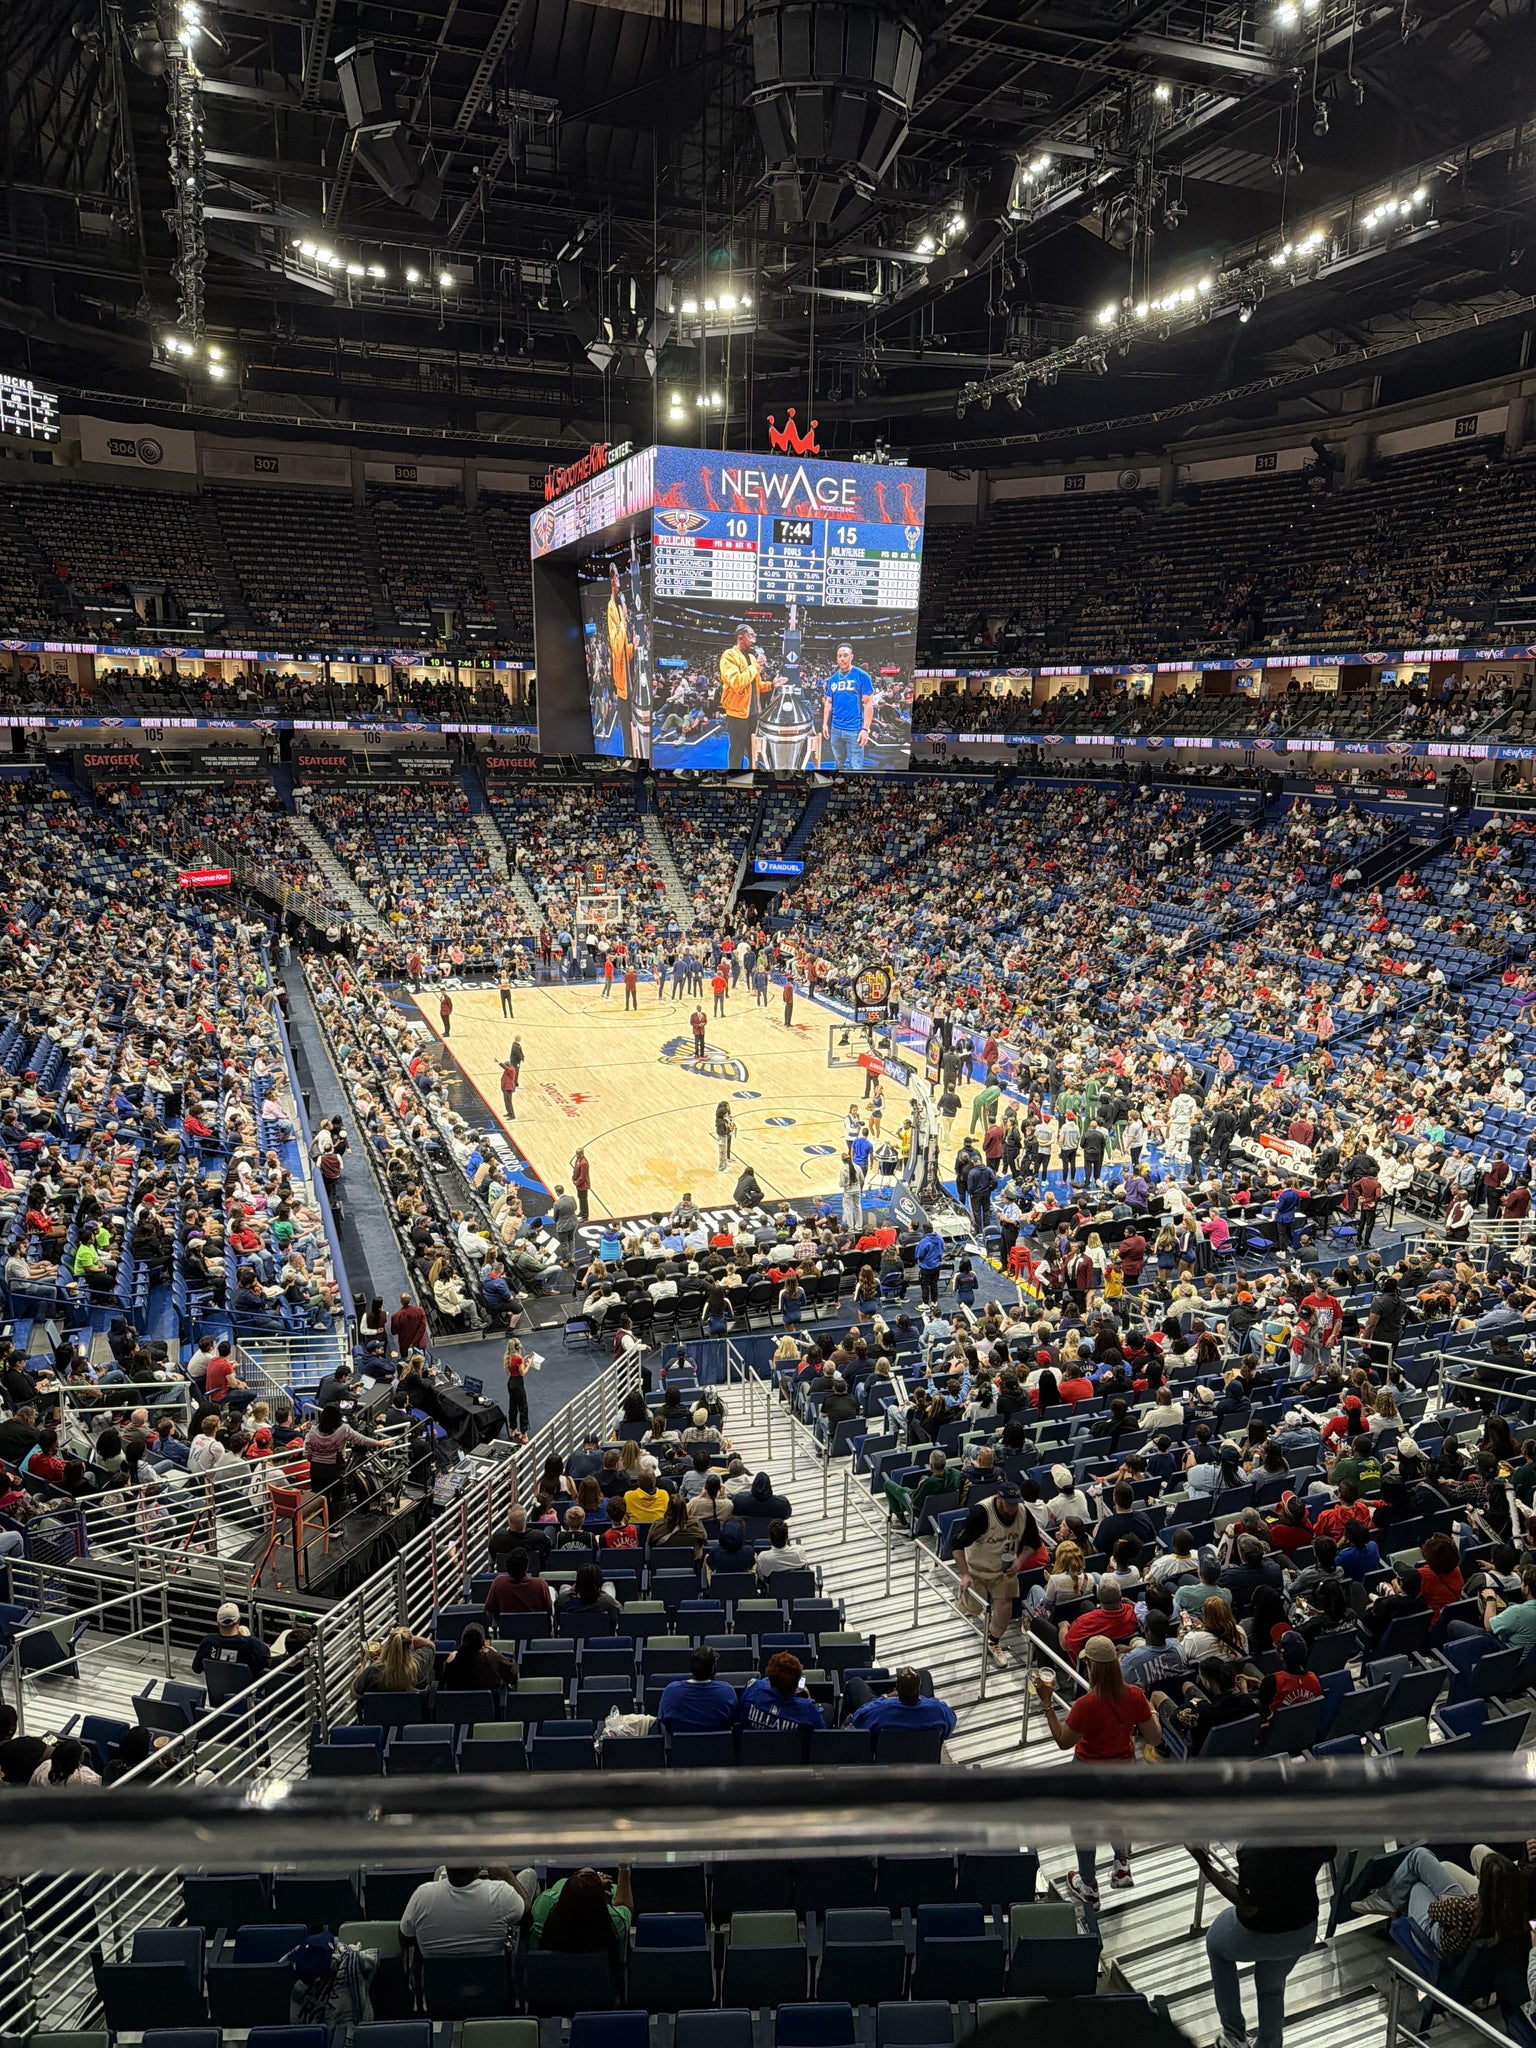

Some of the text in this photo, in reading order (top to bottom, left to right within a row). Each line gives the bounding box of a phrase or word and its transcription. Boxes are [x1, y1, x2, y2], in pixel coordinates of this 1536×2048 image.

[1456, 420, 1475, 433] 314
[112, 442, 134, 454] 306
[256, 458, 276, 470] 307
[553, 441, 633, 494] SMOOTHIE KING CENTER
[1257, 456, 1274, 468] 313
[396, 469, 416, 479] 308
[722, 465, 856, 510] NEWAGE
[1066, 478, 1083, 488] 312
[727, 518, 747, 537] 10
[781, 522, 811, 538] 7:44
[658, 535, 696, 547] PELICANS
[837, 527, 857, 544] 15
[768, 547, 815, 558] 0 FOULS 1
[831, 547, 865, 557] MILWAUKEE
[768, 558, 774, 567] 6
[810, 561, 815, 569] 7
[673, 569, 705, 577] MATKOVIC
[1476, 648, 1504, 659] NEWAGE
[144, 729, 163, 740] 105
[363, 732, 381, 743] 106
[515, 735, 530, 747] 107
[932, 743, 946, 755] 109
[1111, 747, 1124, 759] 110
[1503, 748, 1533, 759] NEWAGE
[83, 754, 139, 767] SEATGEEK
[298, 756, 347, 766] SEATGEEK
[486, 757, 537, 768] SEATGEEK
[1245, 750, 1255, 764] 111
[1402, 756, 1417, 771] 112
[769, 863, 800, 872] FANDUEL
[1241, 1139, 1248, 1147] G
[1251, 1144, 1258, 1153] G
